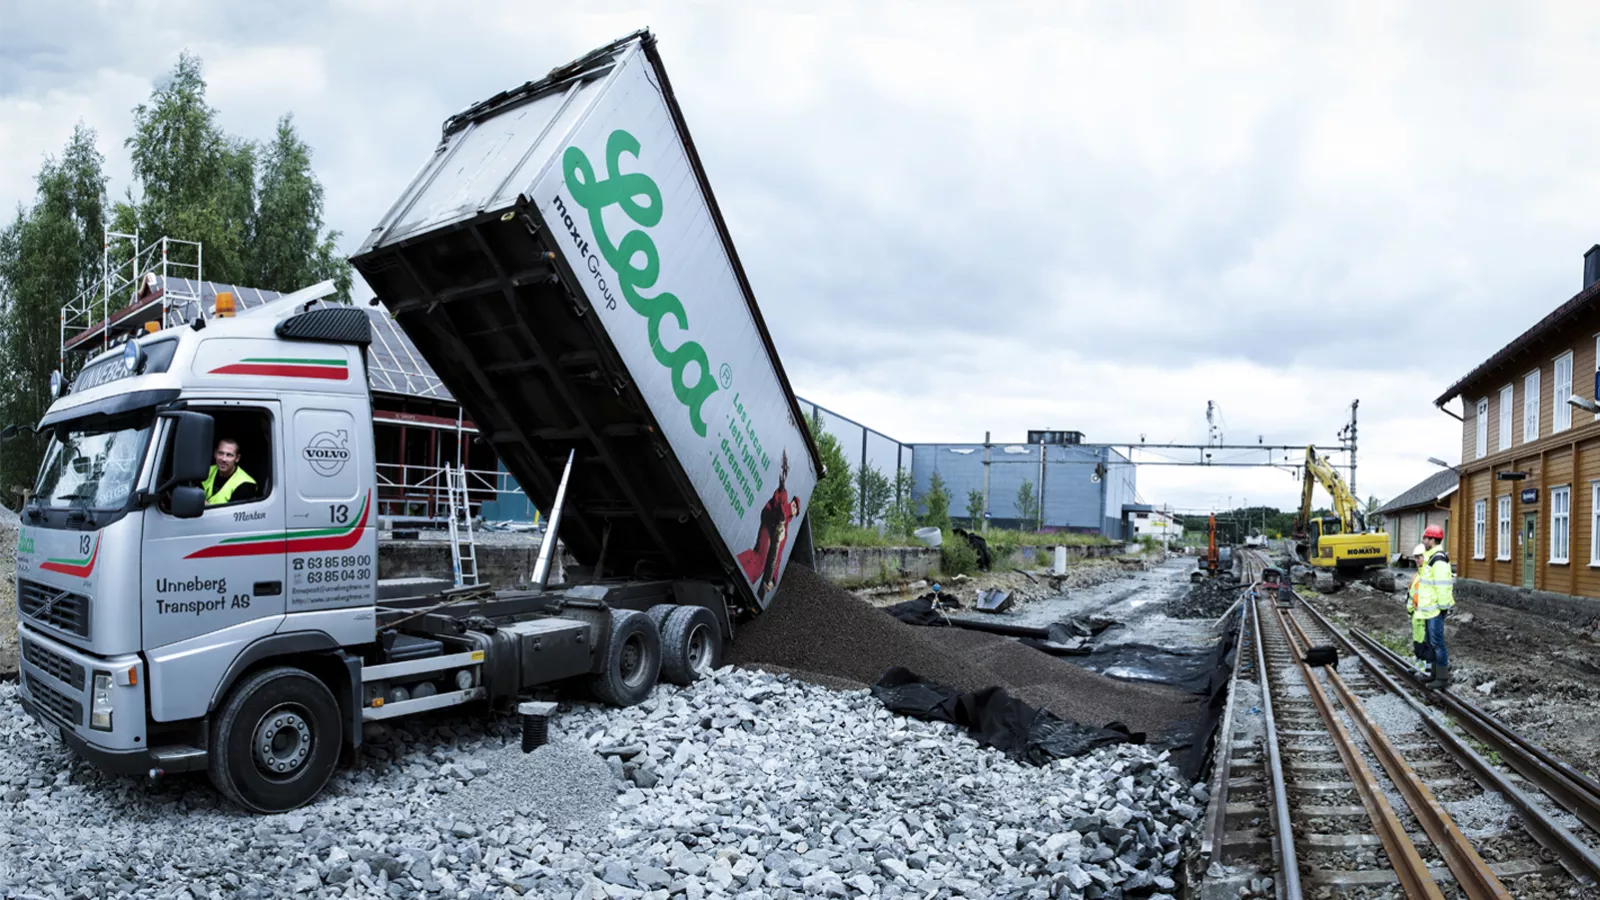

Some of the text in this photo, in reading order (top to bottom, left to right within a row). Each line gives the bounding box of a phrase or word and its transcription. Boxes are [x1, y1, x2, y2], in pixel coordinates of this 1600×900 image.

[553, 195, 617, 311] maxit Group
[563, 129, 720, 438] Leca
[745, 419, 762, 456] Leca
[305, 449, 348, 459] VOLVO
[721, 438, 755, 508] drenering
[741, 443, 763, 492] fylling
[711, 453, 745, 520] isolasjon
[329, 504, 349, 523] 13
[79, 534, 91, 555] 13
[1347, 547, 1381, 555] KOMATSU
[307, 554, 371, 569] 63 85 89 00
[156, 575, 227, 594] Unneberg
[307, 568, 371, 584] 63 85 04 30
[156, 594, 250, 616] Transport AS
